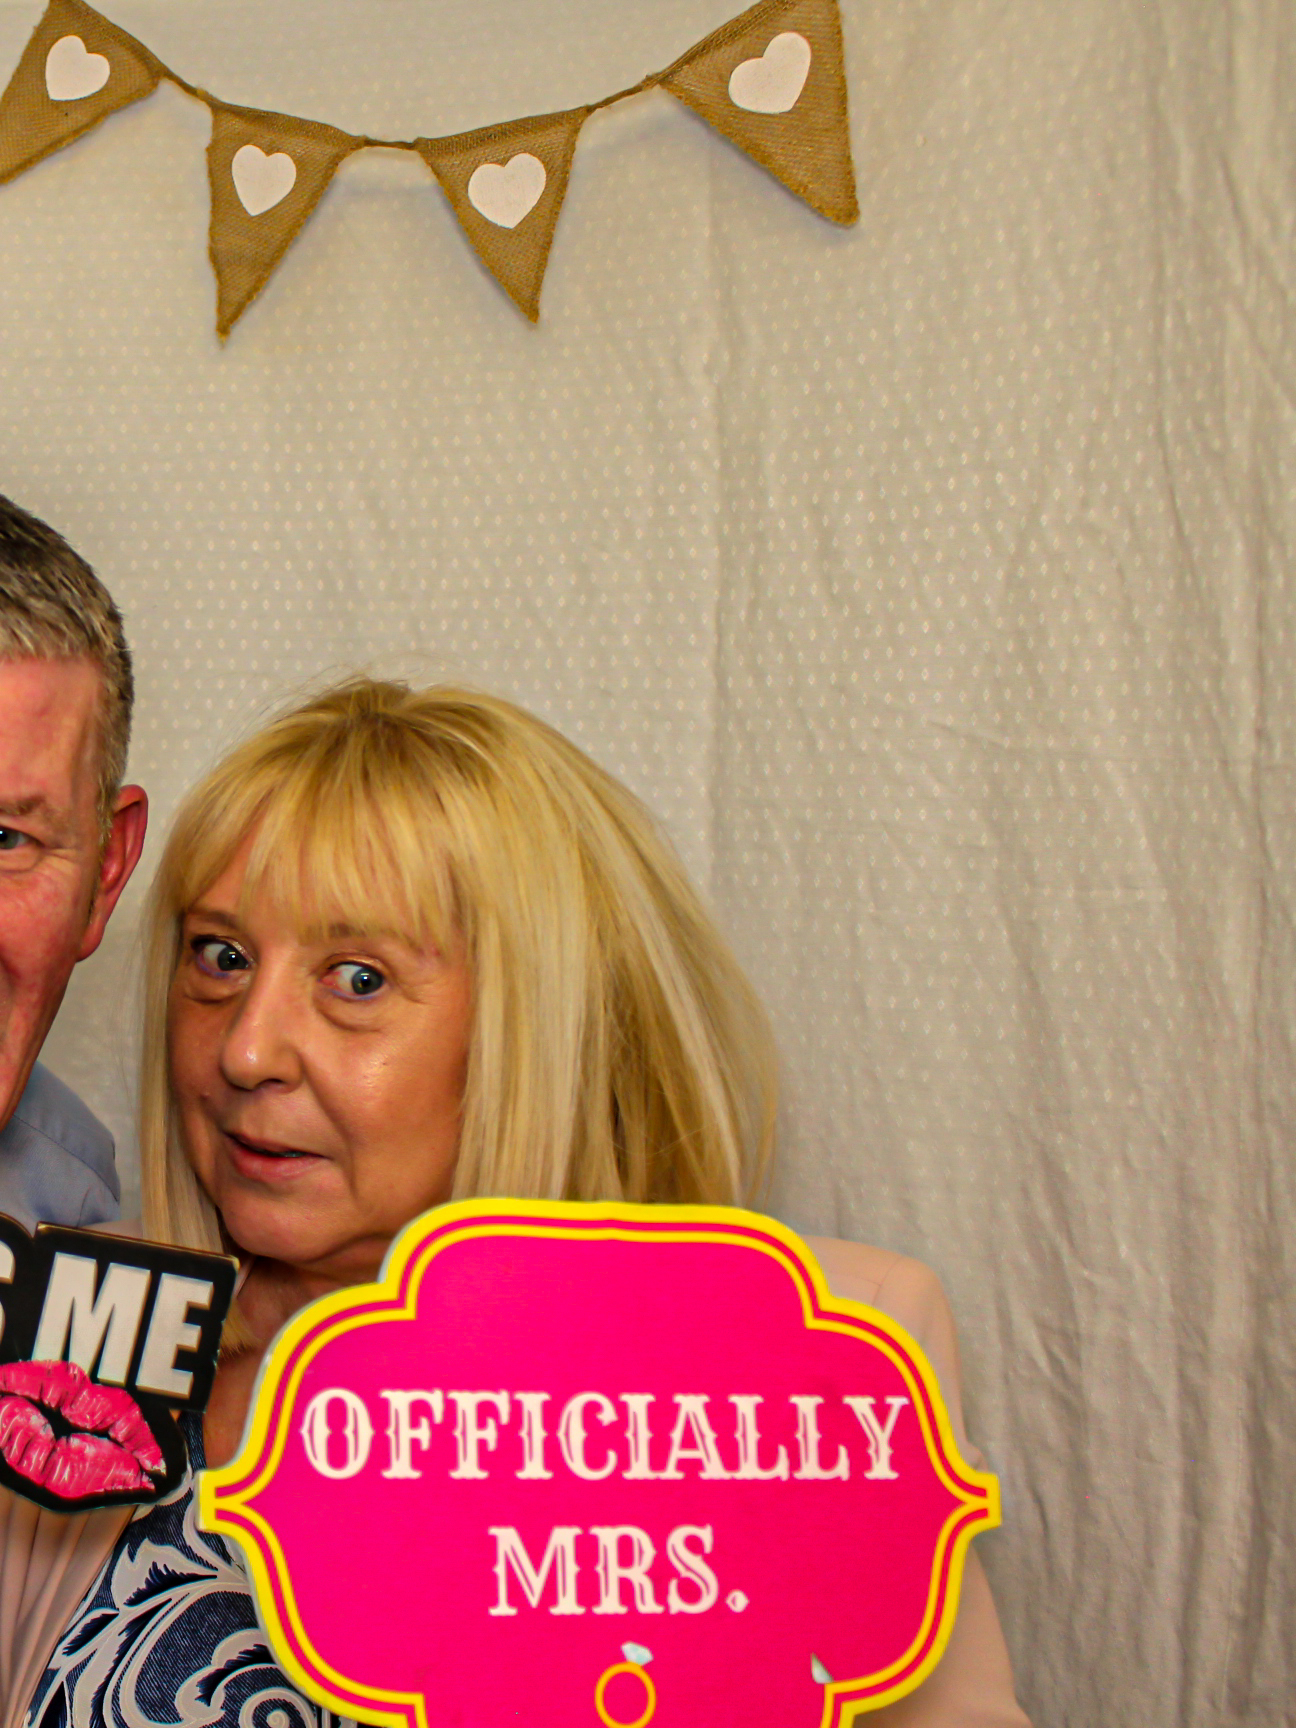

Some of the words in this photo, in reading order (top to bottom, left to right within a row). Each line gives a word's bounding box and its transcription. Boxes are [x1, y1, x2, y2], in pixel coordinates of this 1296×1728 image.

[31, 1251, 214, 1398] ME
[301, 1388, 908, 1482] OFFICIALLY
[488, 1525, 750, 1616] MRS.
